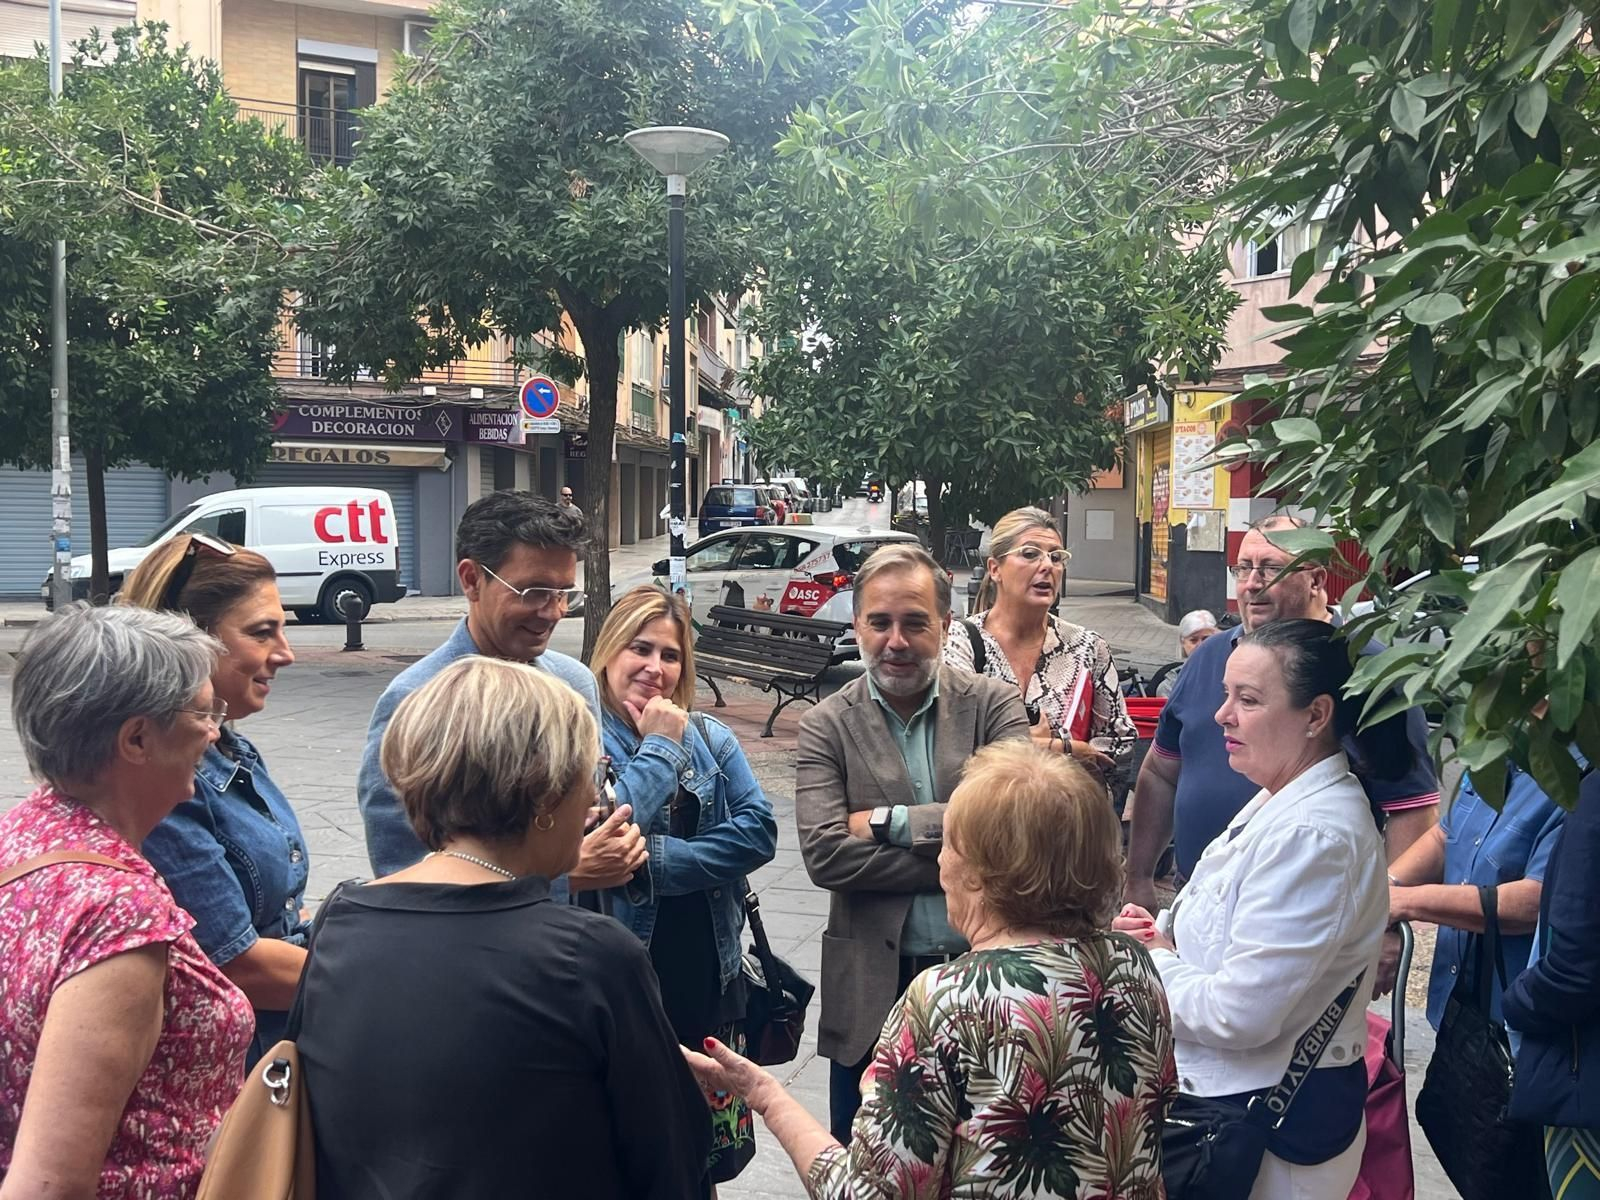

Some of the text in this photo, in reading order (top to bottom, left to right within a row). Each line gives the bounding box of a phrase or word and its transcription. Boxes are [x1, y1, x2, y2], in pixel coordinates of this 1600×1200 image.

[469, 413, 518, 426] ALIMENTACION
[311, 421, 415, 436] DECORACION
[479, 428, 508, 440] BEBIDAS
[271, 447, 391, 465] REGALOS
[314, 499, 388, 544] ctt
[318, 551, 385, 568] Express
[796, 589, 820, 600] ASC
